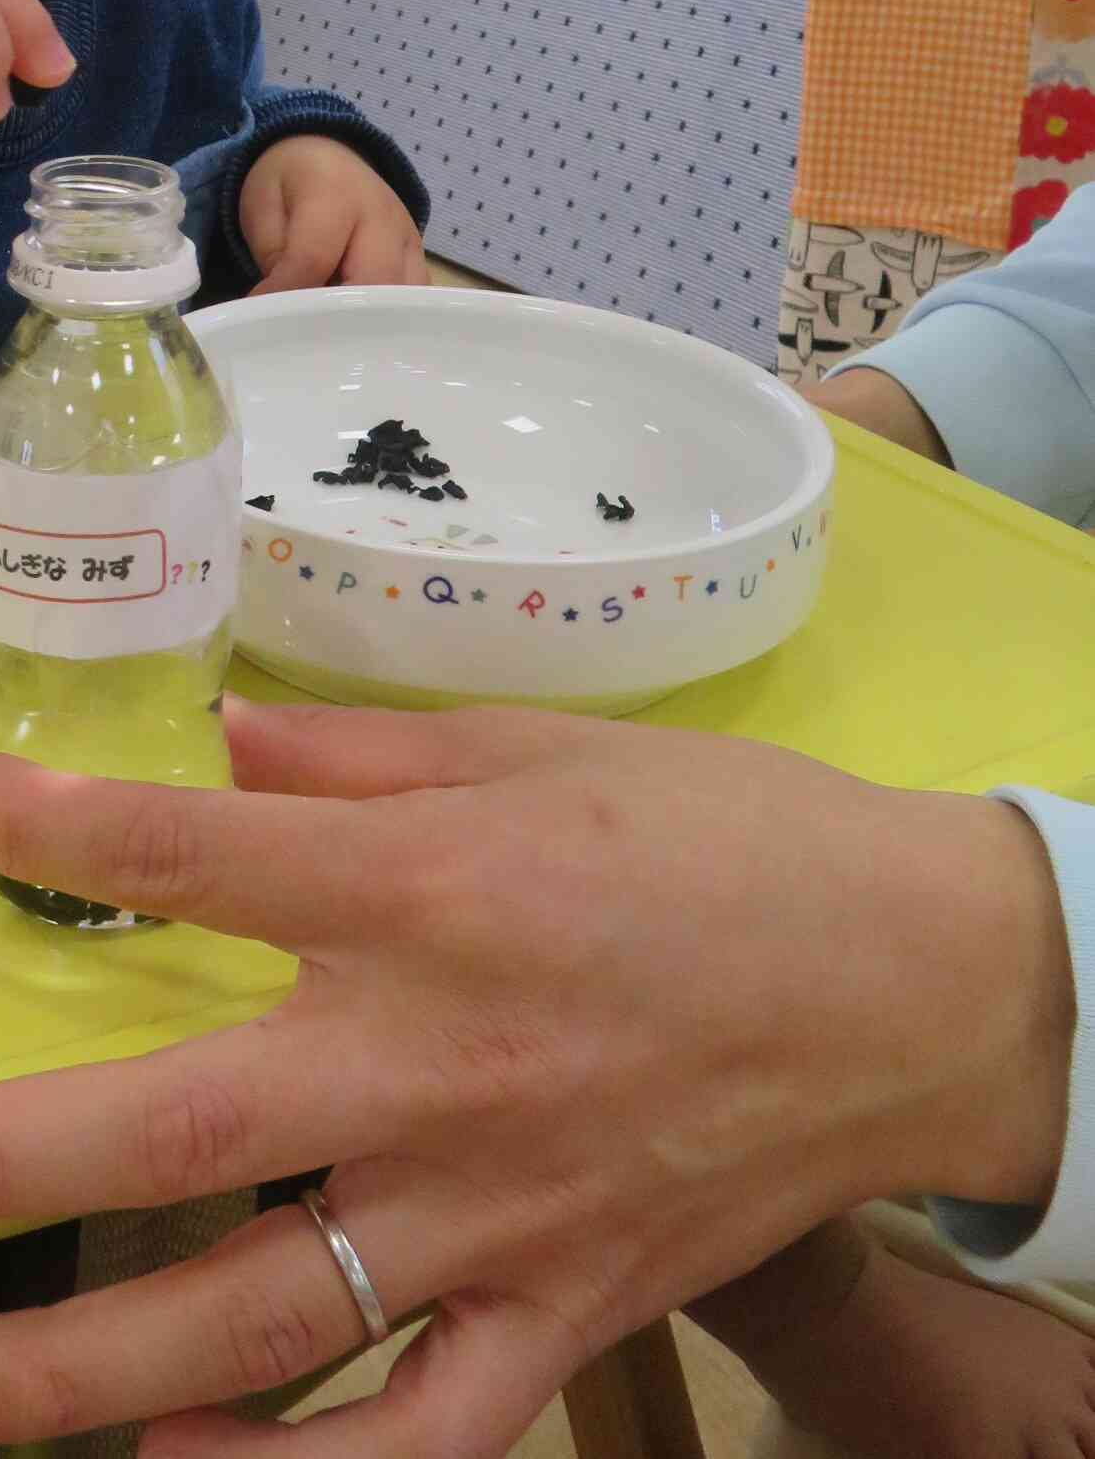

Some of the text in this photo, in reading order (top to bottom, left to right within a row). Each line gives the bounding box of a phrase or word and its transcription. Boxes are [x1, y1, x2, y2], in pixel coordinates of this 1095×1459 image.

[82, 554, 134, 581] みず
[267, 538, 293, 563] O
[336, 570, 357, 595] P
[422, 575, 459, 605] Q
[518, 589, 546, 619] R
[600, 596, 624, 623] S
[673, 573, 694, 602] T
[739, 572, 758, 600] U
